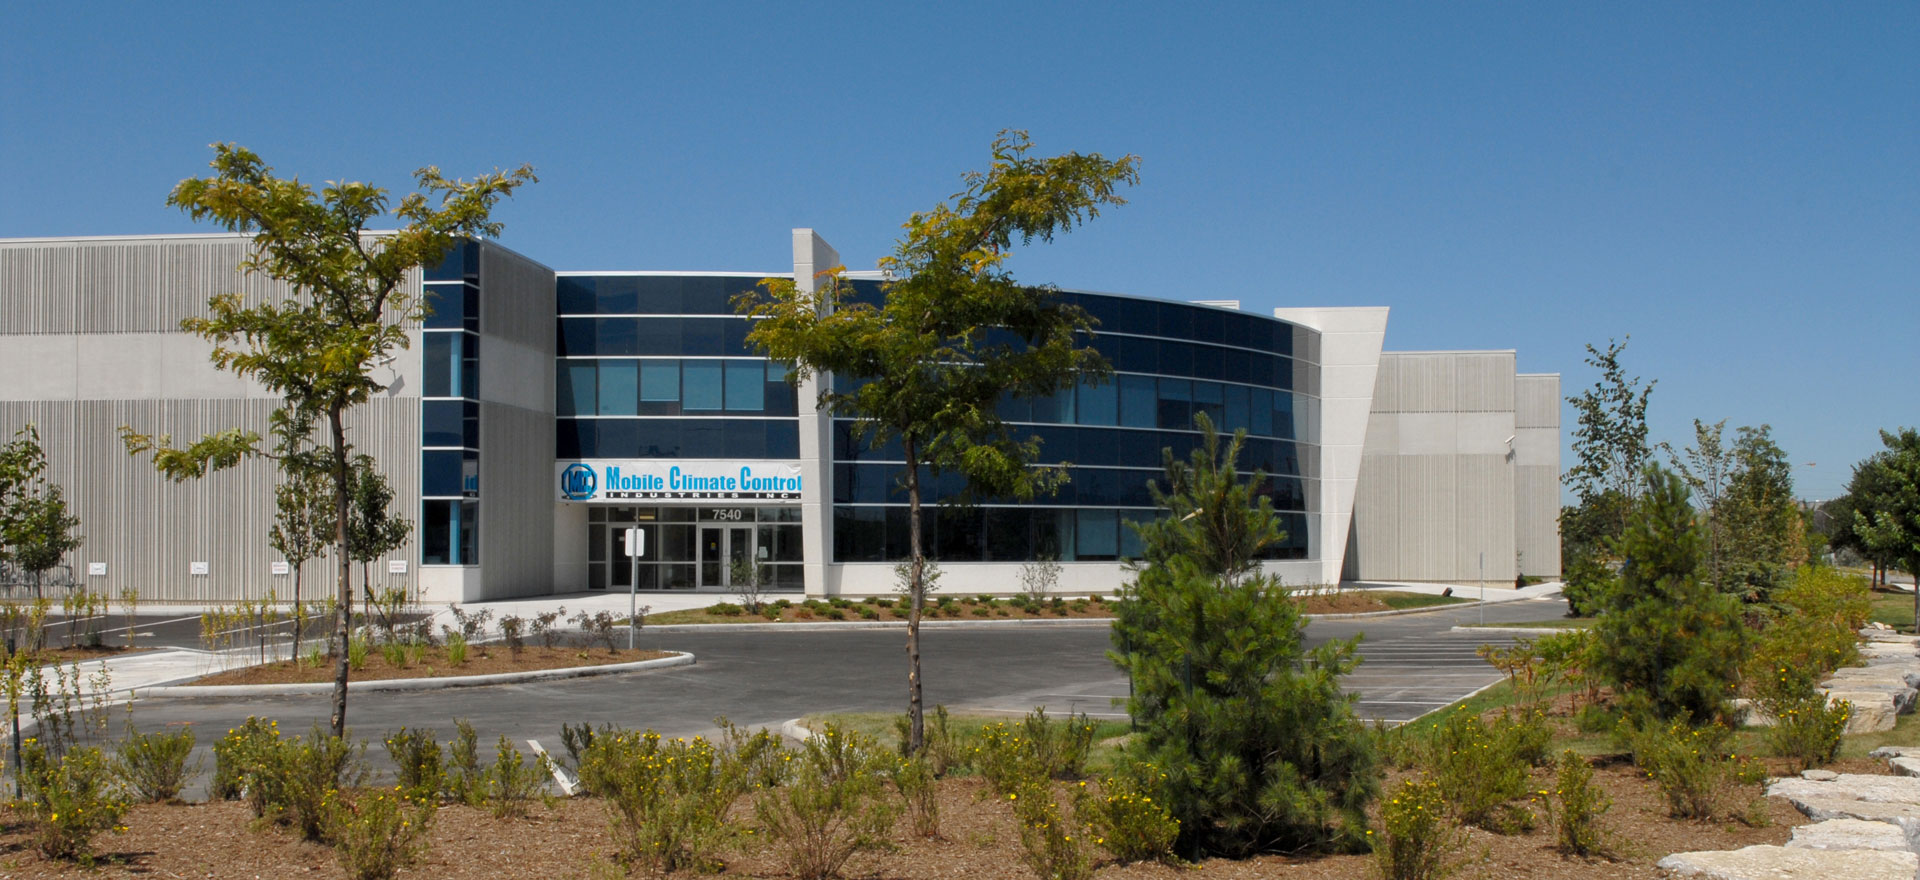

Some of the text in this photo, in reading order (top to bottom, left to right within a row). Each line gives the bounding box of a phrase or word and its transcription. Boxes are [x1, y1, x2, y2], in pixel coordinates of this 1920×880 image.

[606, 465, 802, 491] Mobile Climate Control
[712, 509, 742, 520] 7540
